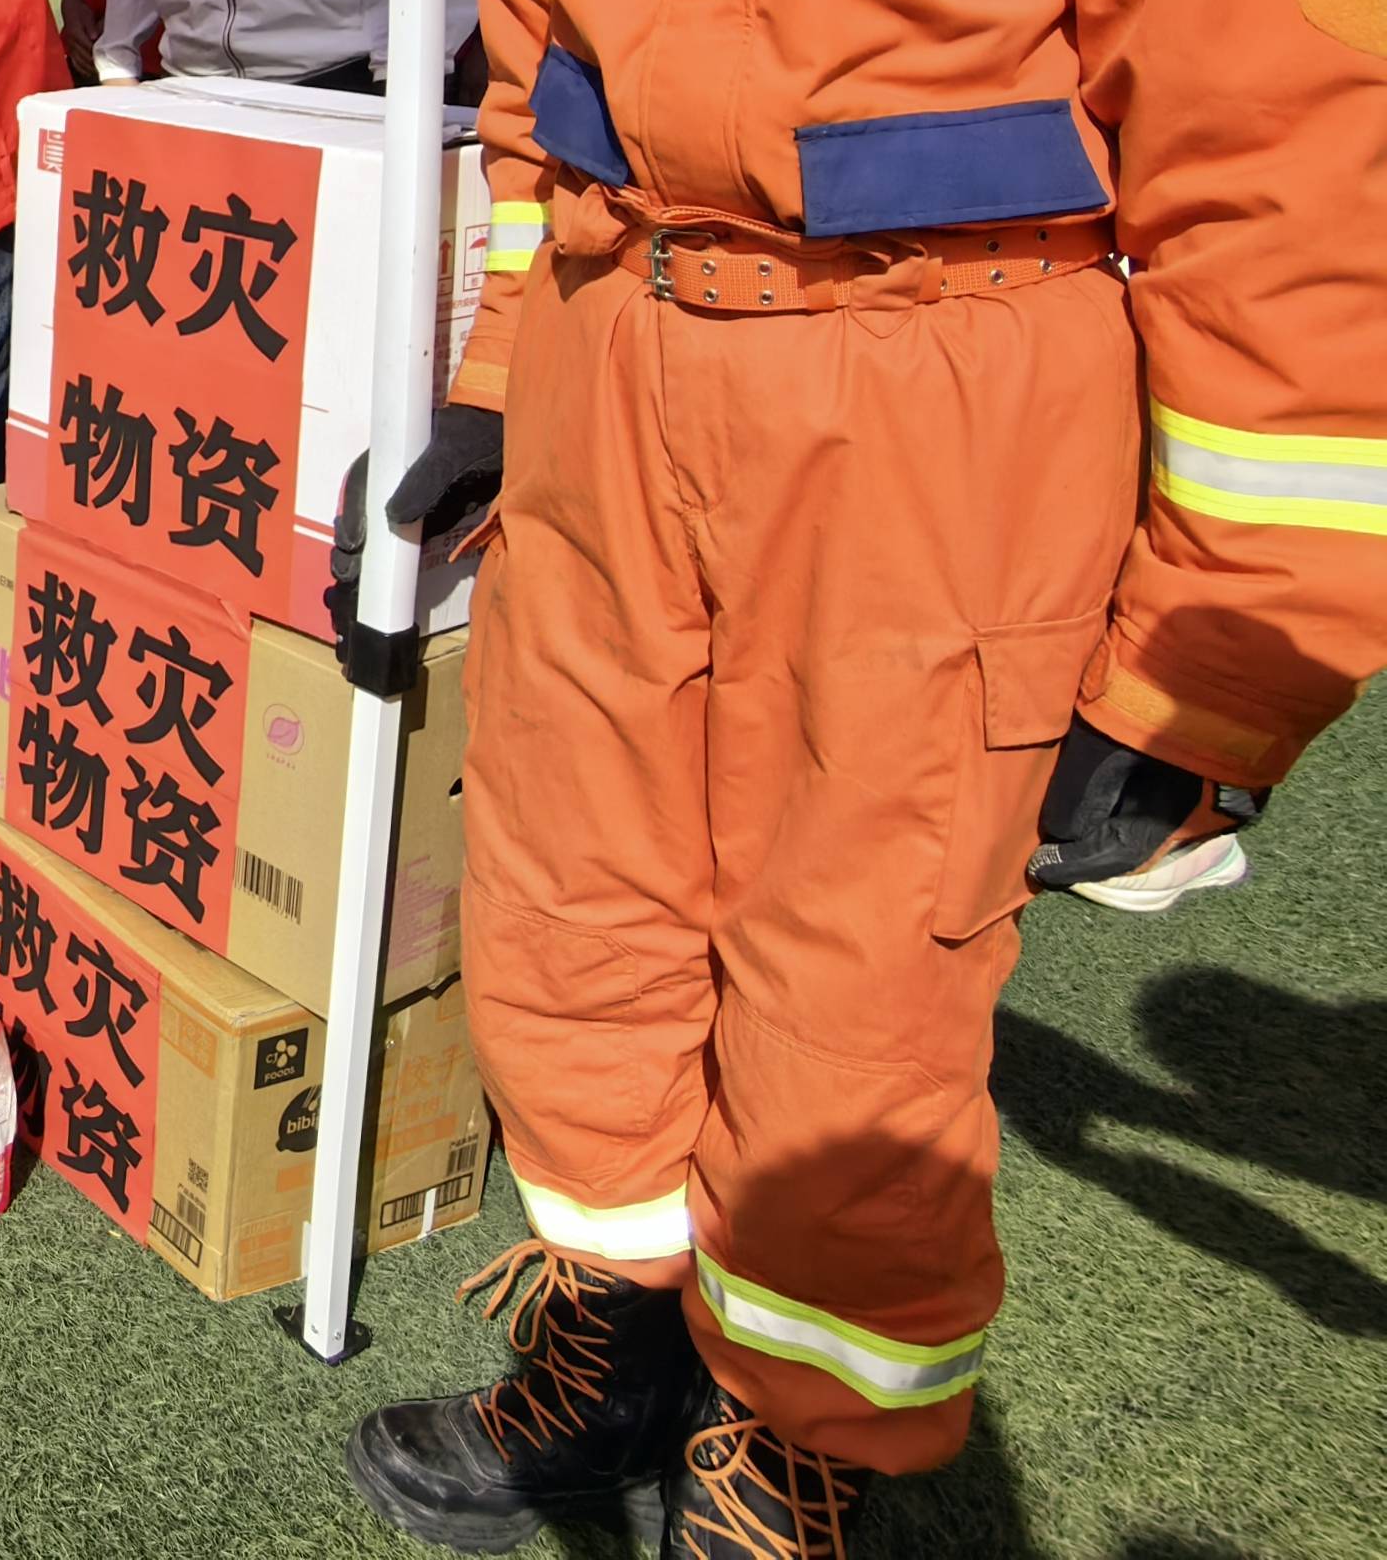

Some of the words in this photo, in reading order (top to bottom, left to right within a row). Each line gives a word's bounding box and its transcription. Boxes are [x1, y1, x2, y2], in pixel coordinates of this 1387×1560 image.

[68, 169, 298, 362] 救灾
[60, 373, 281, 578] 物资
[23, 569, 234, 788] 救灾
[18, 702, 223, 924] 物资
[286, 1112, 321, 1134] bibi
